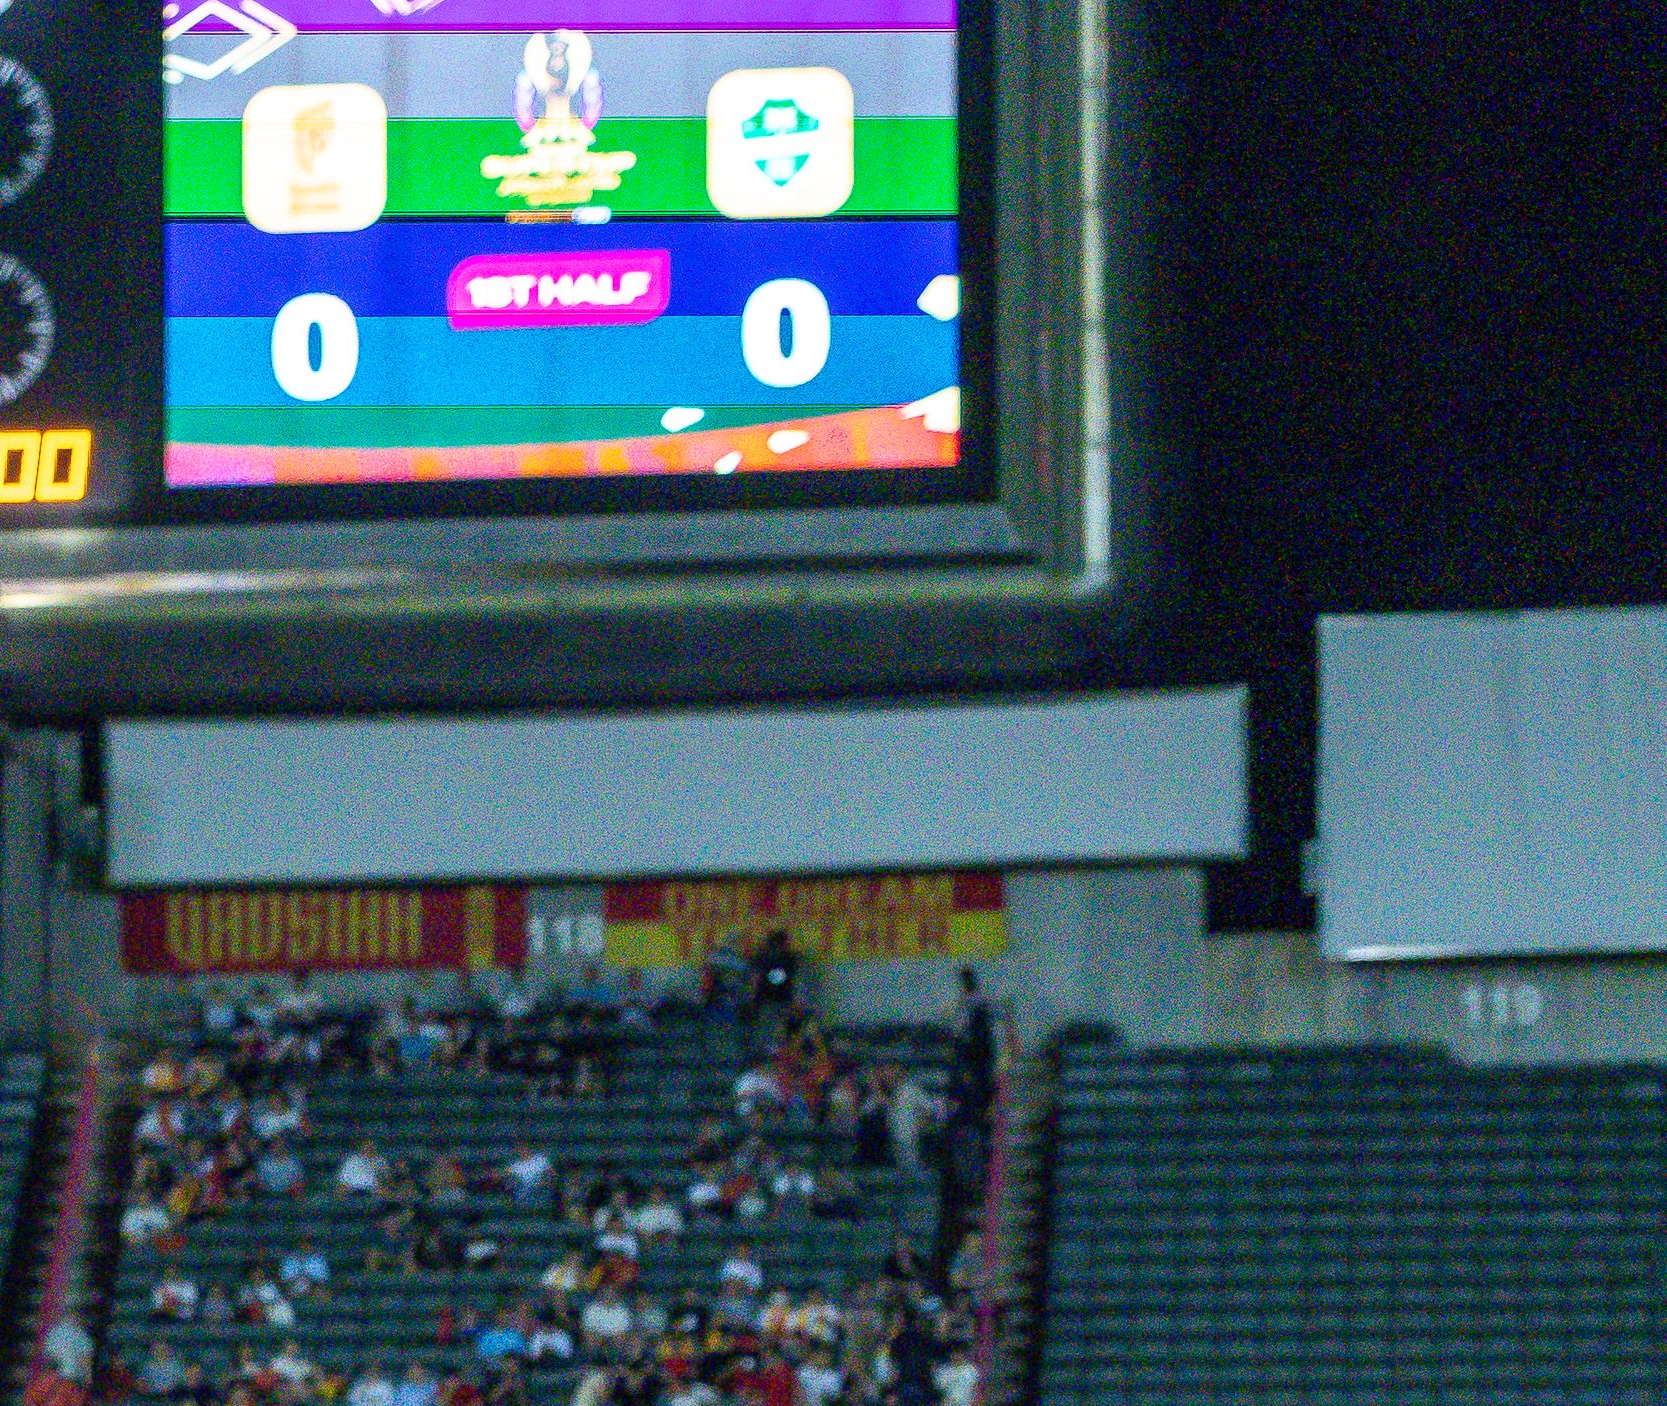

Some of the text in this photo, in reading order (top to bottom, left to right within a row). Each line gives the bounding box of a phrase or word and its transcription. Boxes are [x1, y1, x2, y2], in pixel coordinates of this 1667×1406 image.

[467, 271, 652, 309] 1ST HALF
[742, 279, 830, 386] 0
[272, 293, 358, 400] 0
